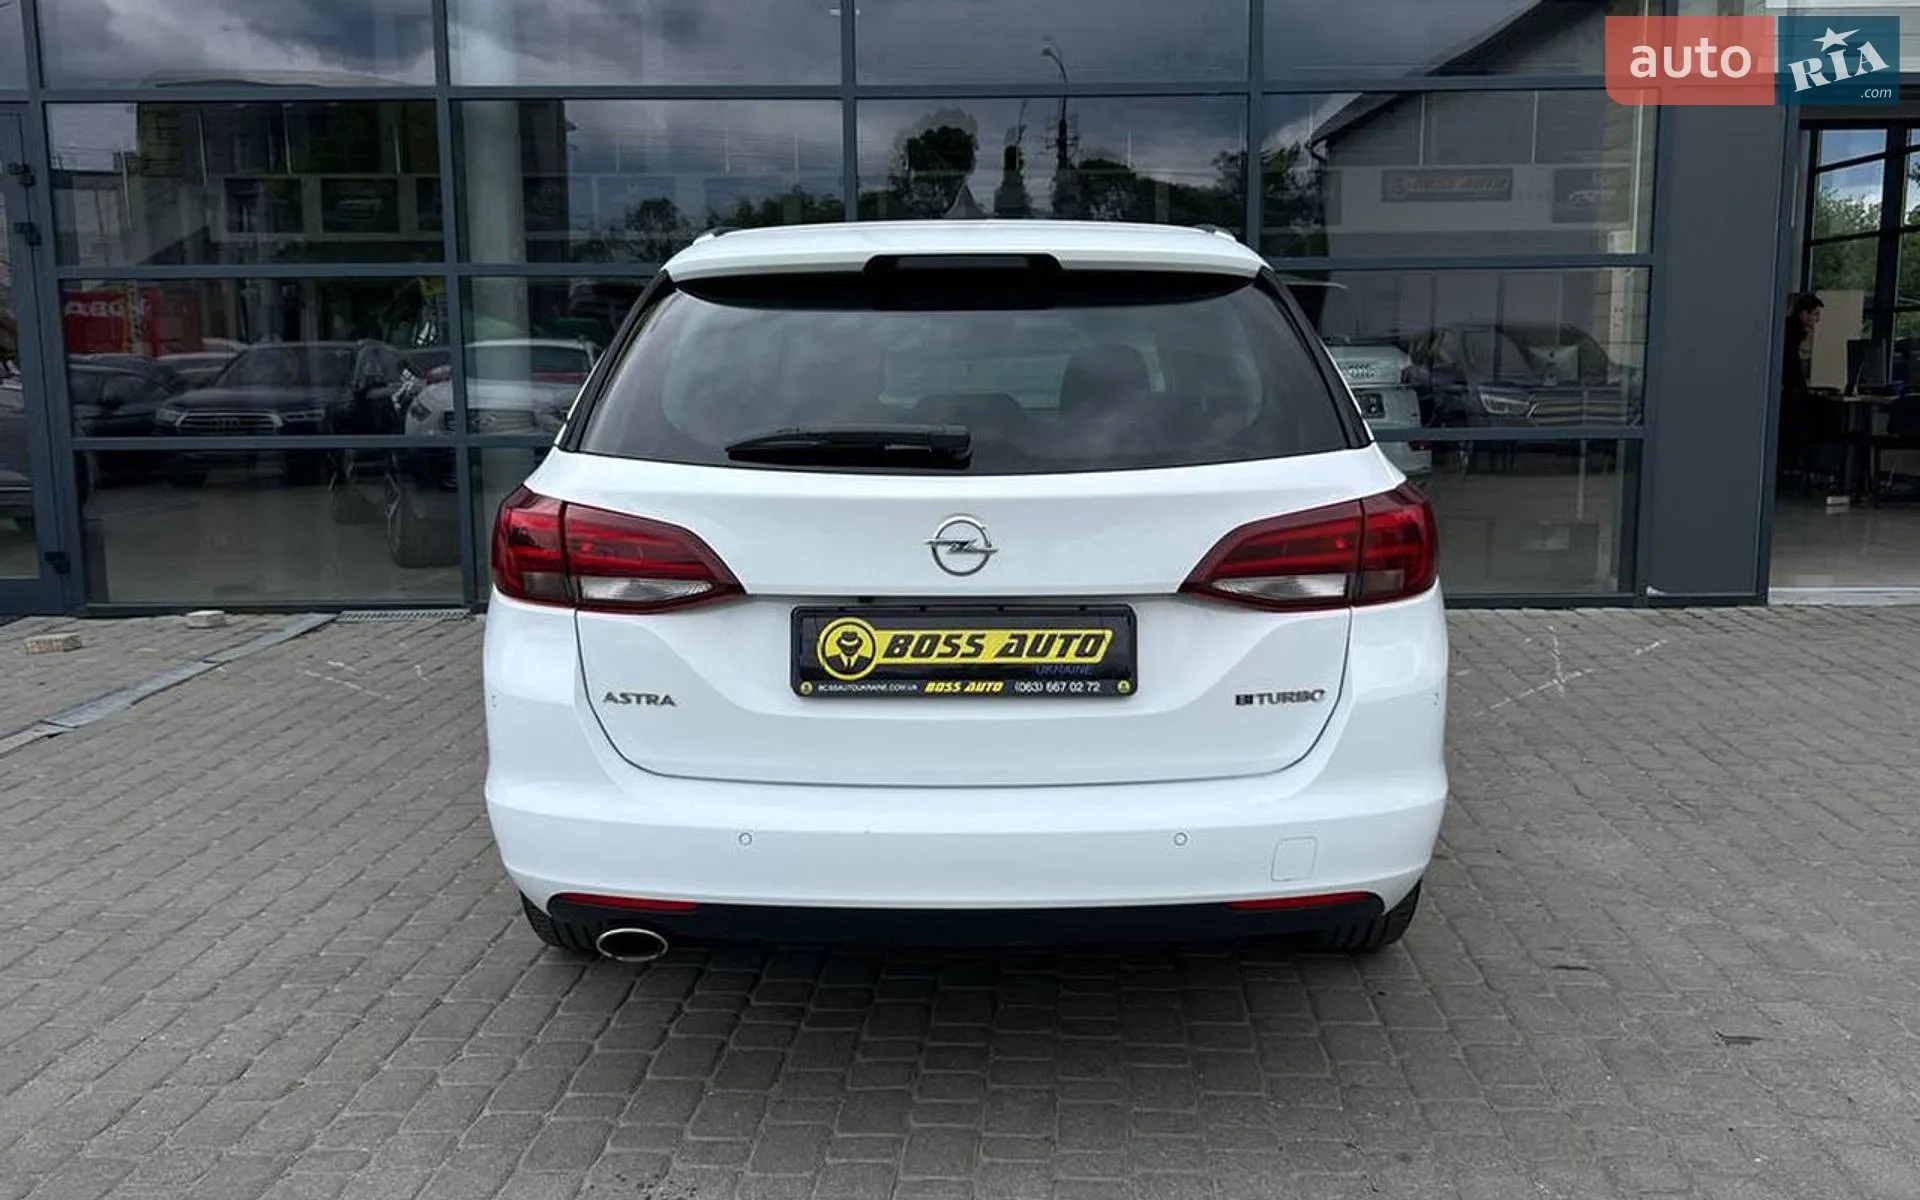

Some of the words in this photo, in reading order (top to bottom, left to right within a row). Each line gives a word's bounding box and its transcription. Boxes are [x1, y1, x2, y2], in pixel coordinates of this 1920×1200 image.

[882, 632, 988, 659] BOSS
[993, 633, 1105, 659] AUTO
[924, 681, 962, 693] BOSS
[964, 681, 1004, 693] AUTO
[1014, 682, 1044, 693] (063)
[1046, 682, 1066, 692] 667
[1069, 682, 1084, 692] 02
[1086, 682, 1100, 692] 72
[604, 692, 676, 706] ASTRA
